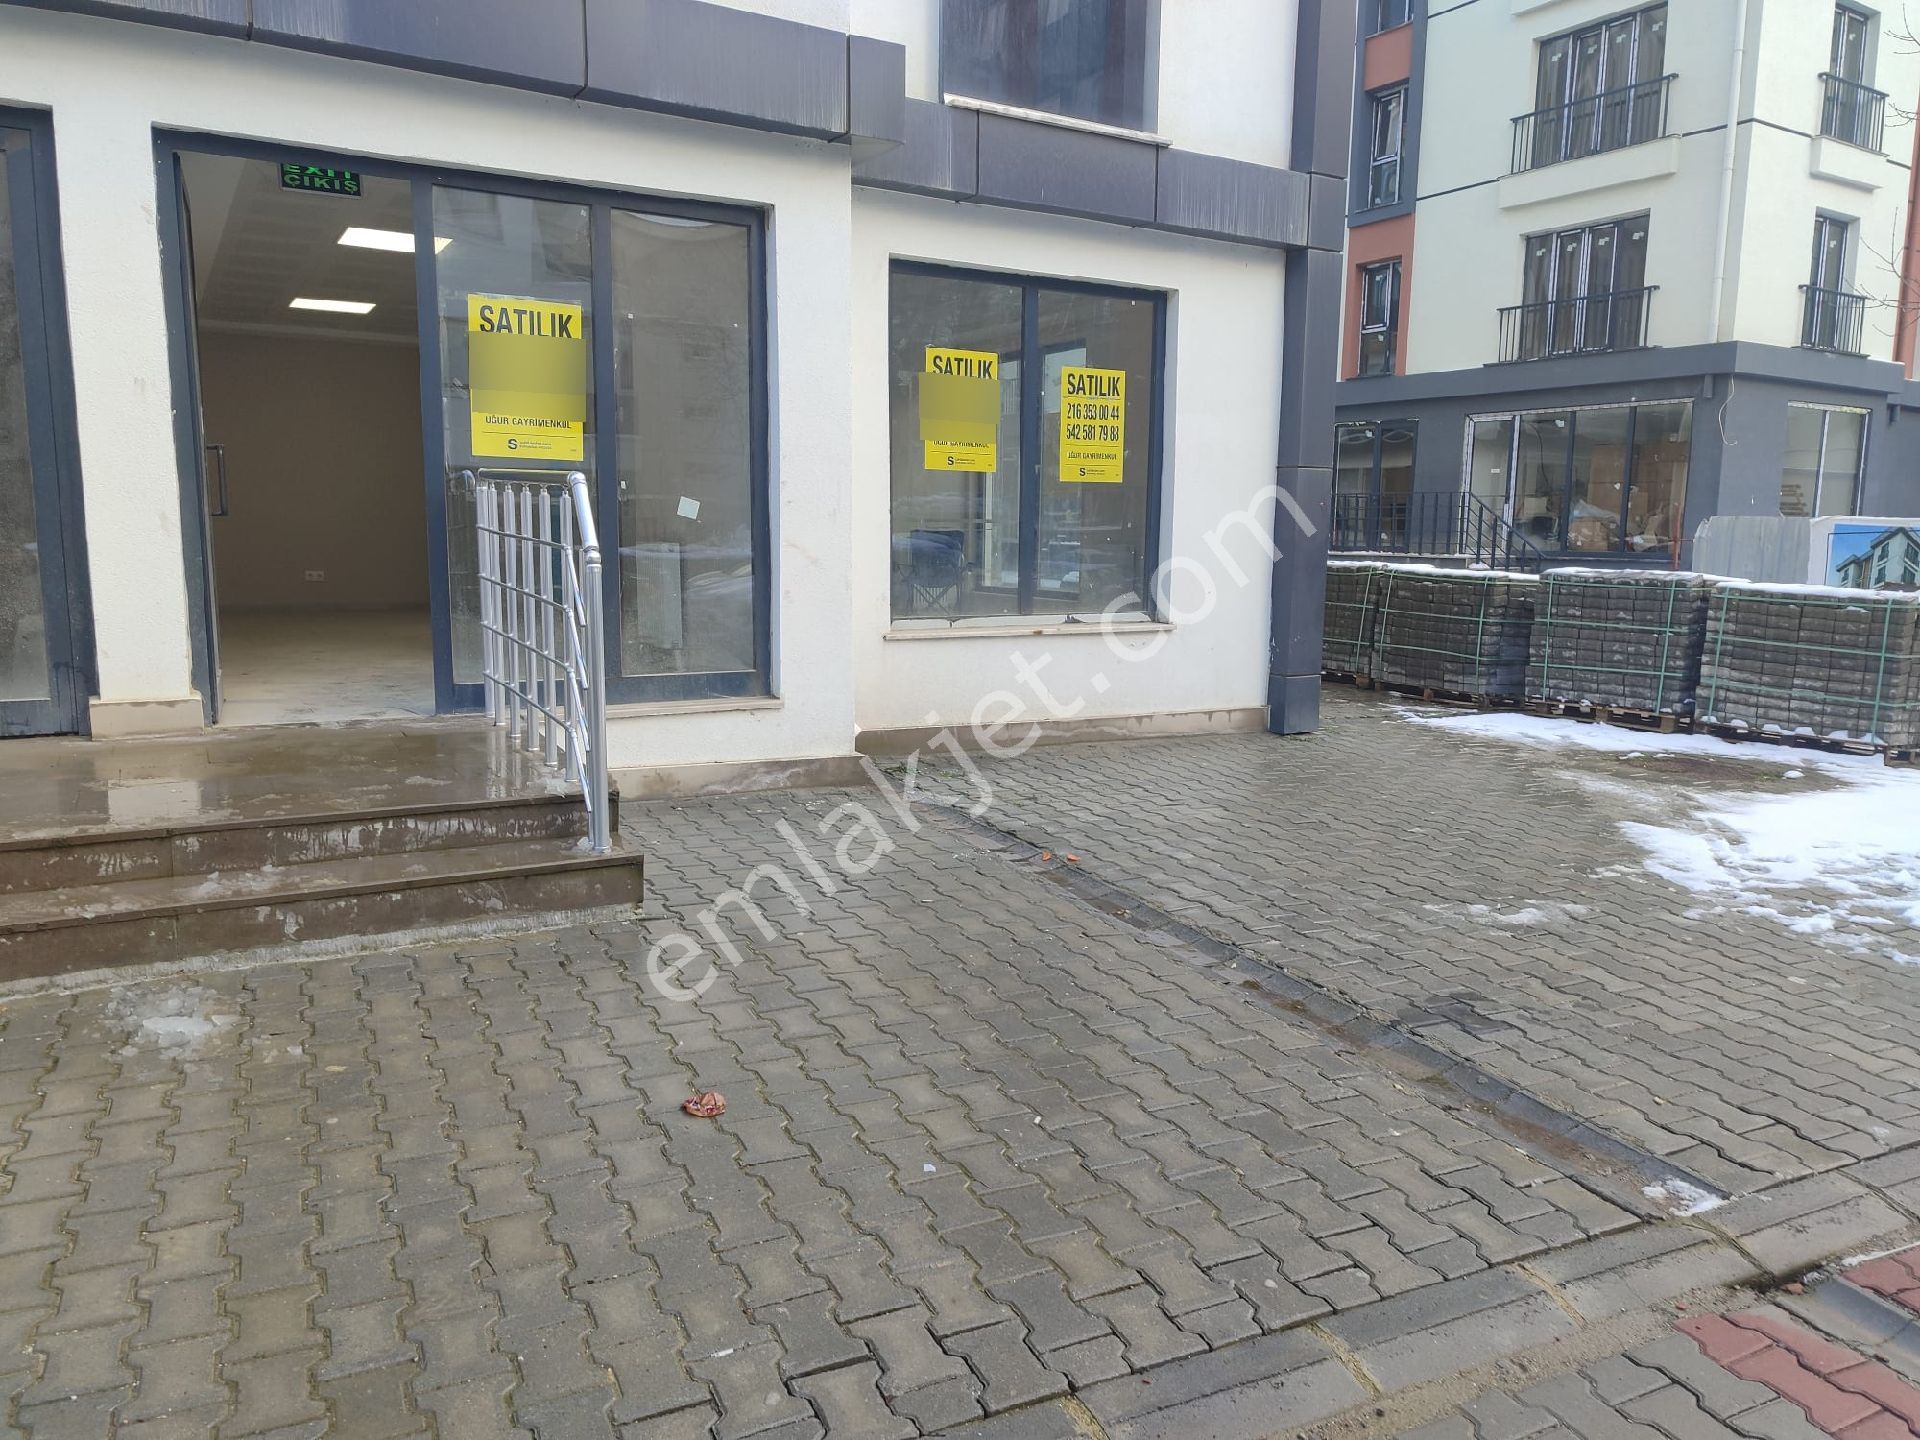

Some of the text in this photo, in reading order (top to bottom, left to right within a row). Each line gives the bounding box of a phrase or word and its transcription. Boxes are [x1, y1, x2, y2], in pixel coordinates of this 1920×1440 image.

[479, 305, 572, 339] SATILIK
[933, 355, 993, 379] SATILIK
[1067, 373, 1120, 397] SATILIK
[1067, 402, 1119, 420] 216 353 00 44
[1066, 423, 1081, 440] 542
[1083, 424, 1096, 441] 581
[1098, 425, 1109, 442] 79
